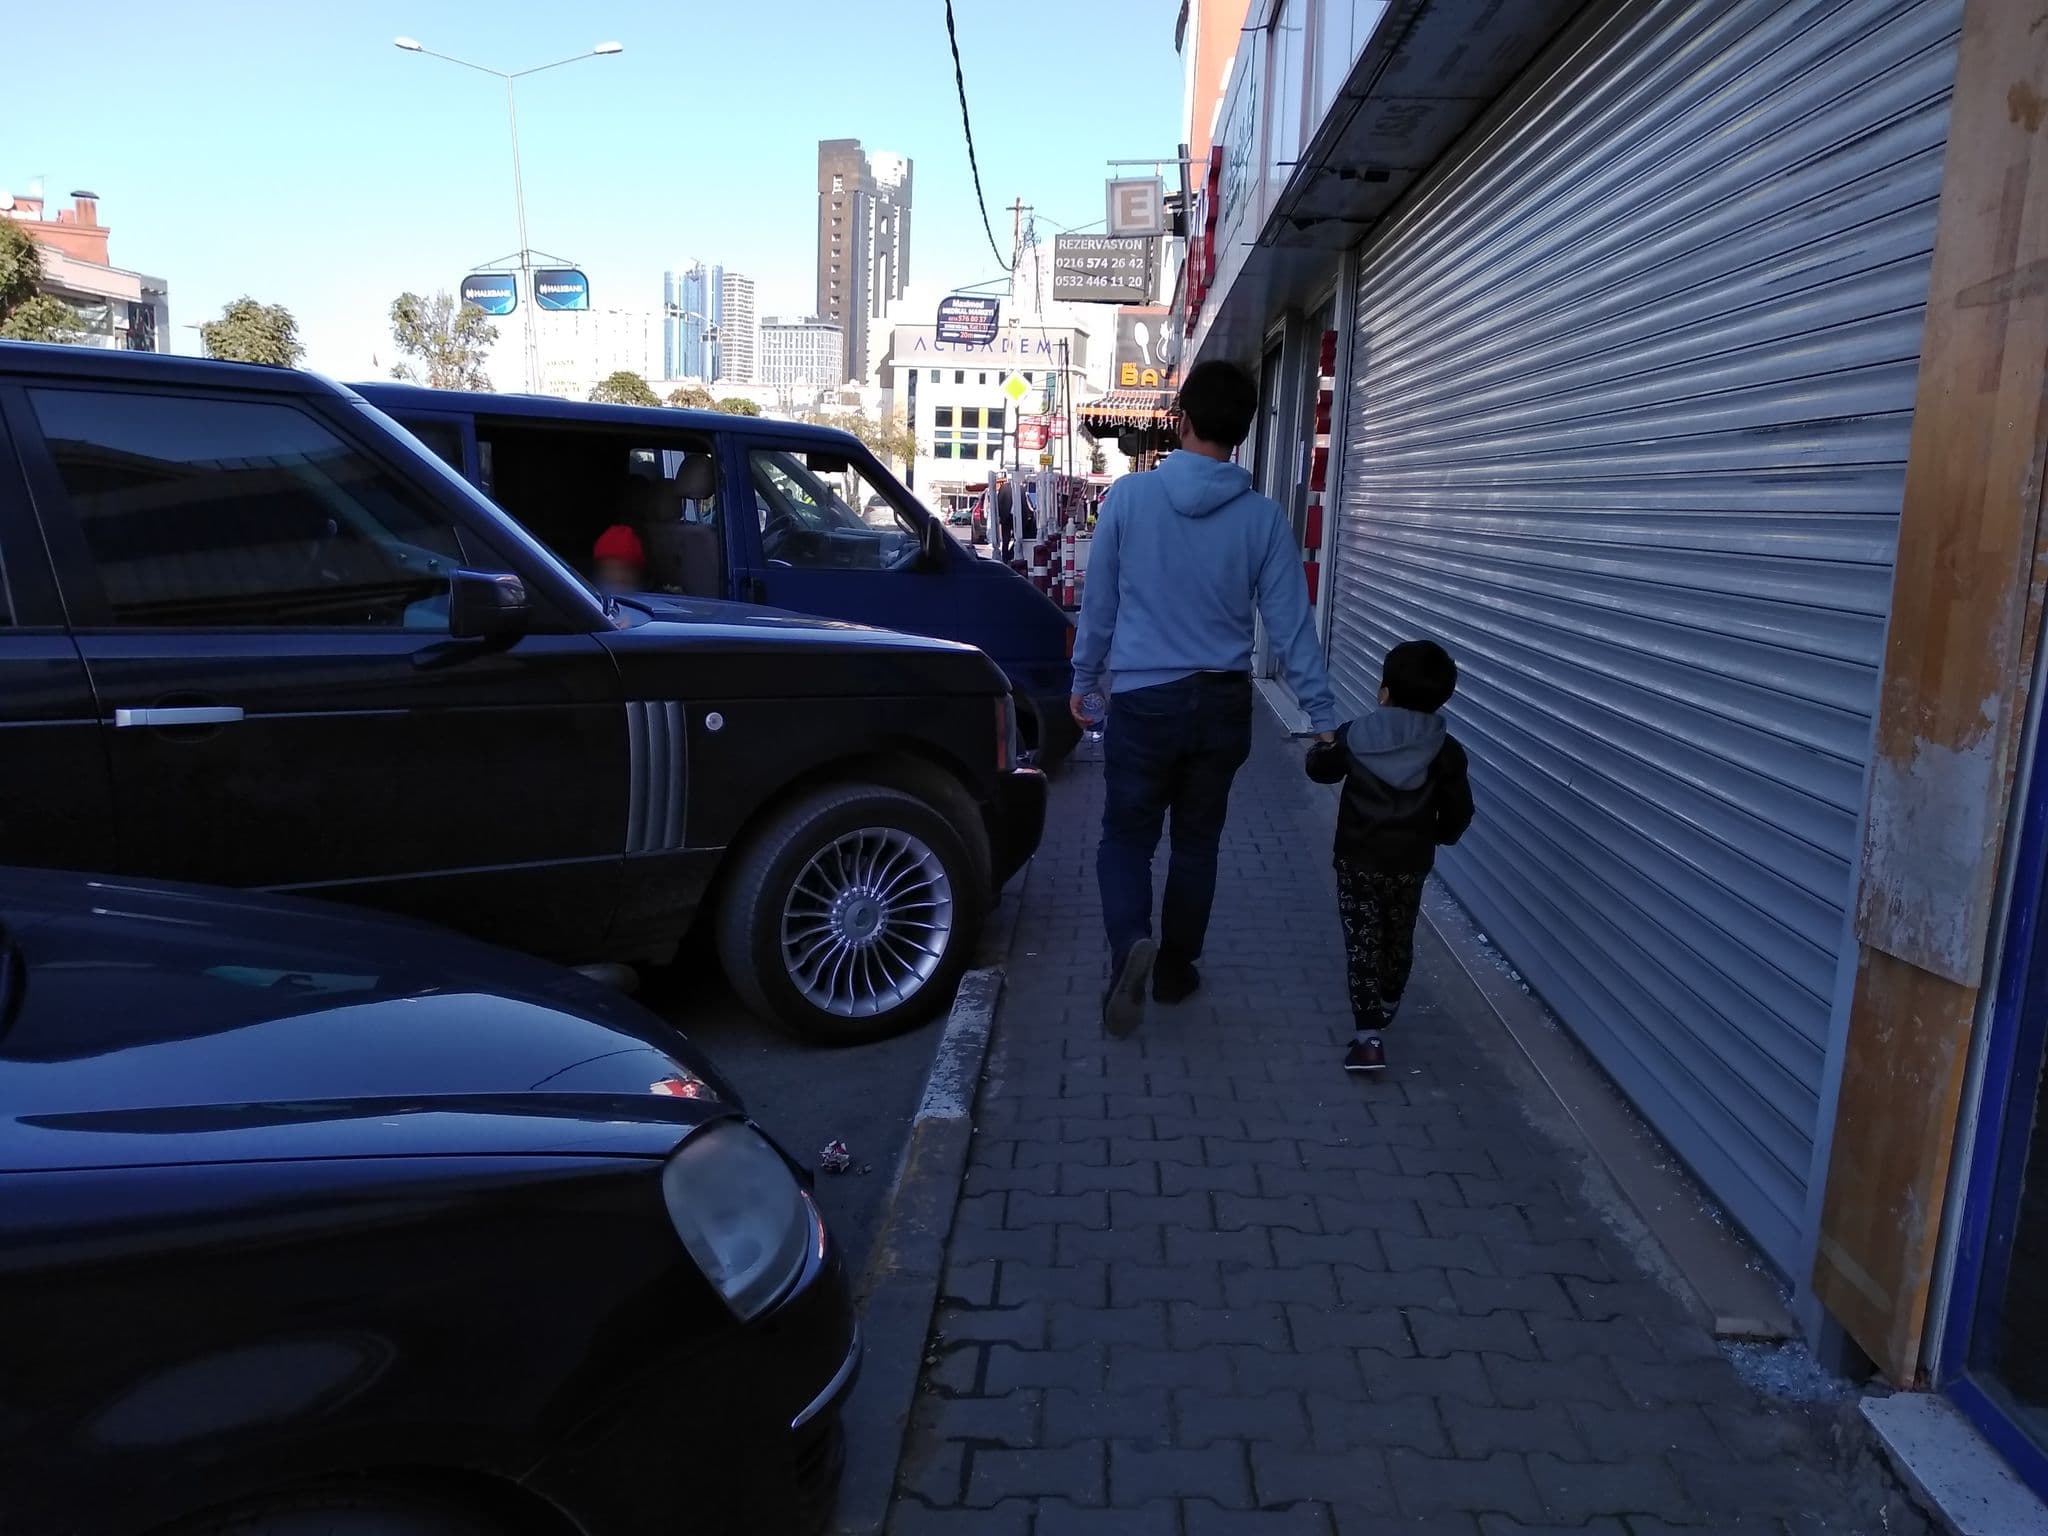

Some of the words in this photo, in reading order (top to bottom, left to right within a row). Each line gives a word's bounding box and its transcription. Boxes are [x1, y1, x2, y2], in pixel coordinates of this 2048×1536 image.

[1121, 190, 1150, 225] E
[1058, 239, 1143, 250] REZERVASYON
[1055, 258, 1084, 268] 0216
[1086, 257, 1108, 269] 574
[1111, 258, 1126, 269] 26
[1128, 258, 1144, 269] 42
[1055, 275, 1084, 287] 0532
[1086, 275, 1108, 287] 446
[1110, 276, 1125, 287] 11
[1128, 276, 1143, 287] 20
[547, 285, 584, 294] HALKBANK
